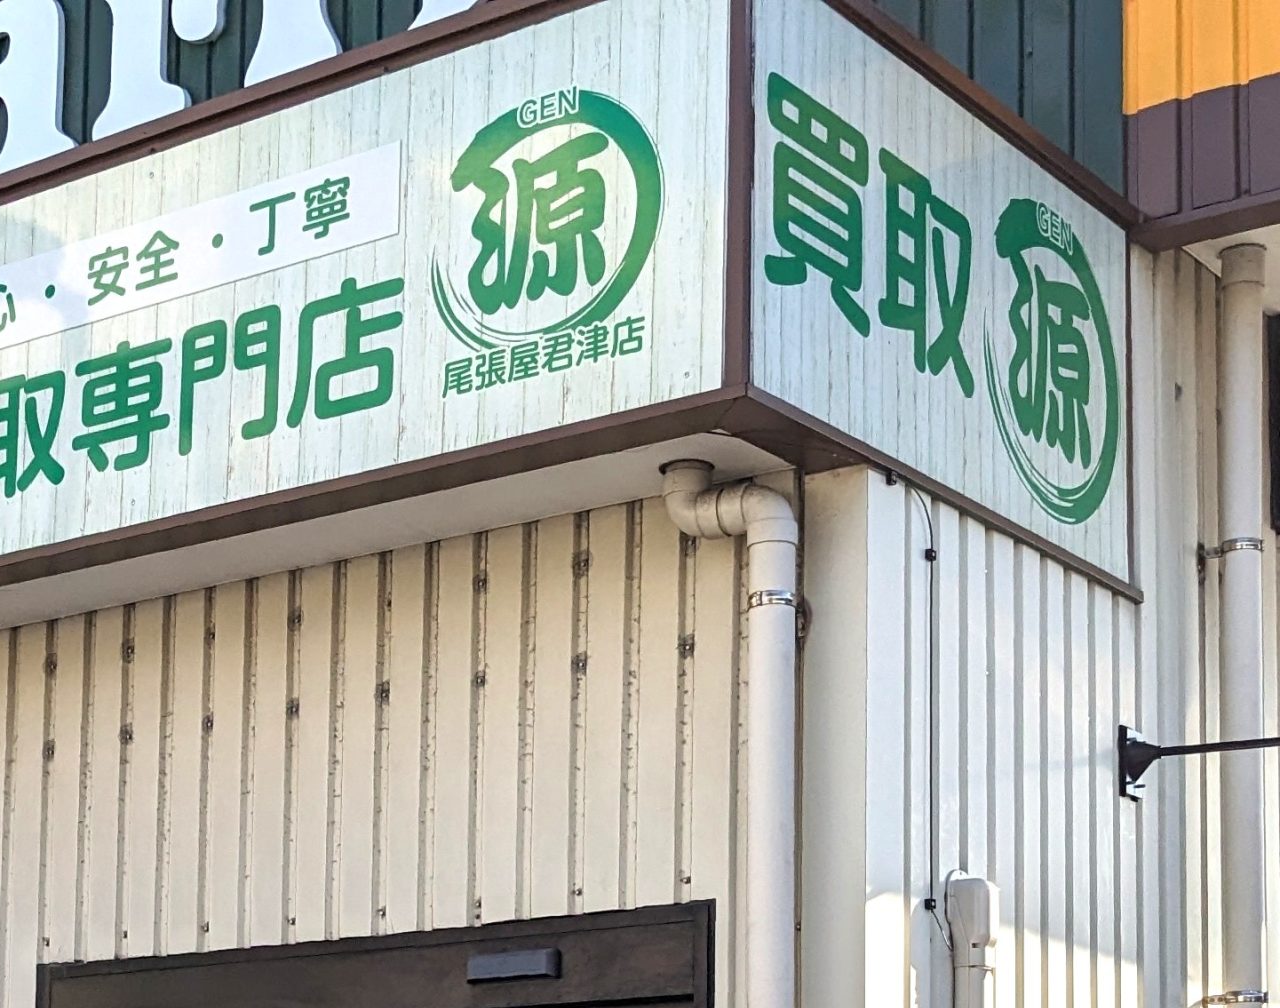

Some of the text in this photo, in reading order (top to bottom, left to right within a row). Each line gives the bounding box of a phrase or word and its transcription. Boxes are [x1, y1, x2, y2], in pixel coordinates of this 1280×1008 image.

[519, 86, 579, 126] GEN
[467, 130, 610, 316] 源
[764, 72, 975, 399] 買取
[1036, 201, 1074, 256] GEN
[441, 316, 646, 398] 尾張屋君津店
[1008, 263, 1092, 470] 源
